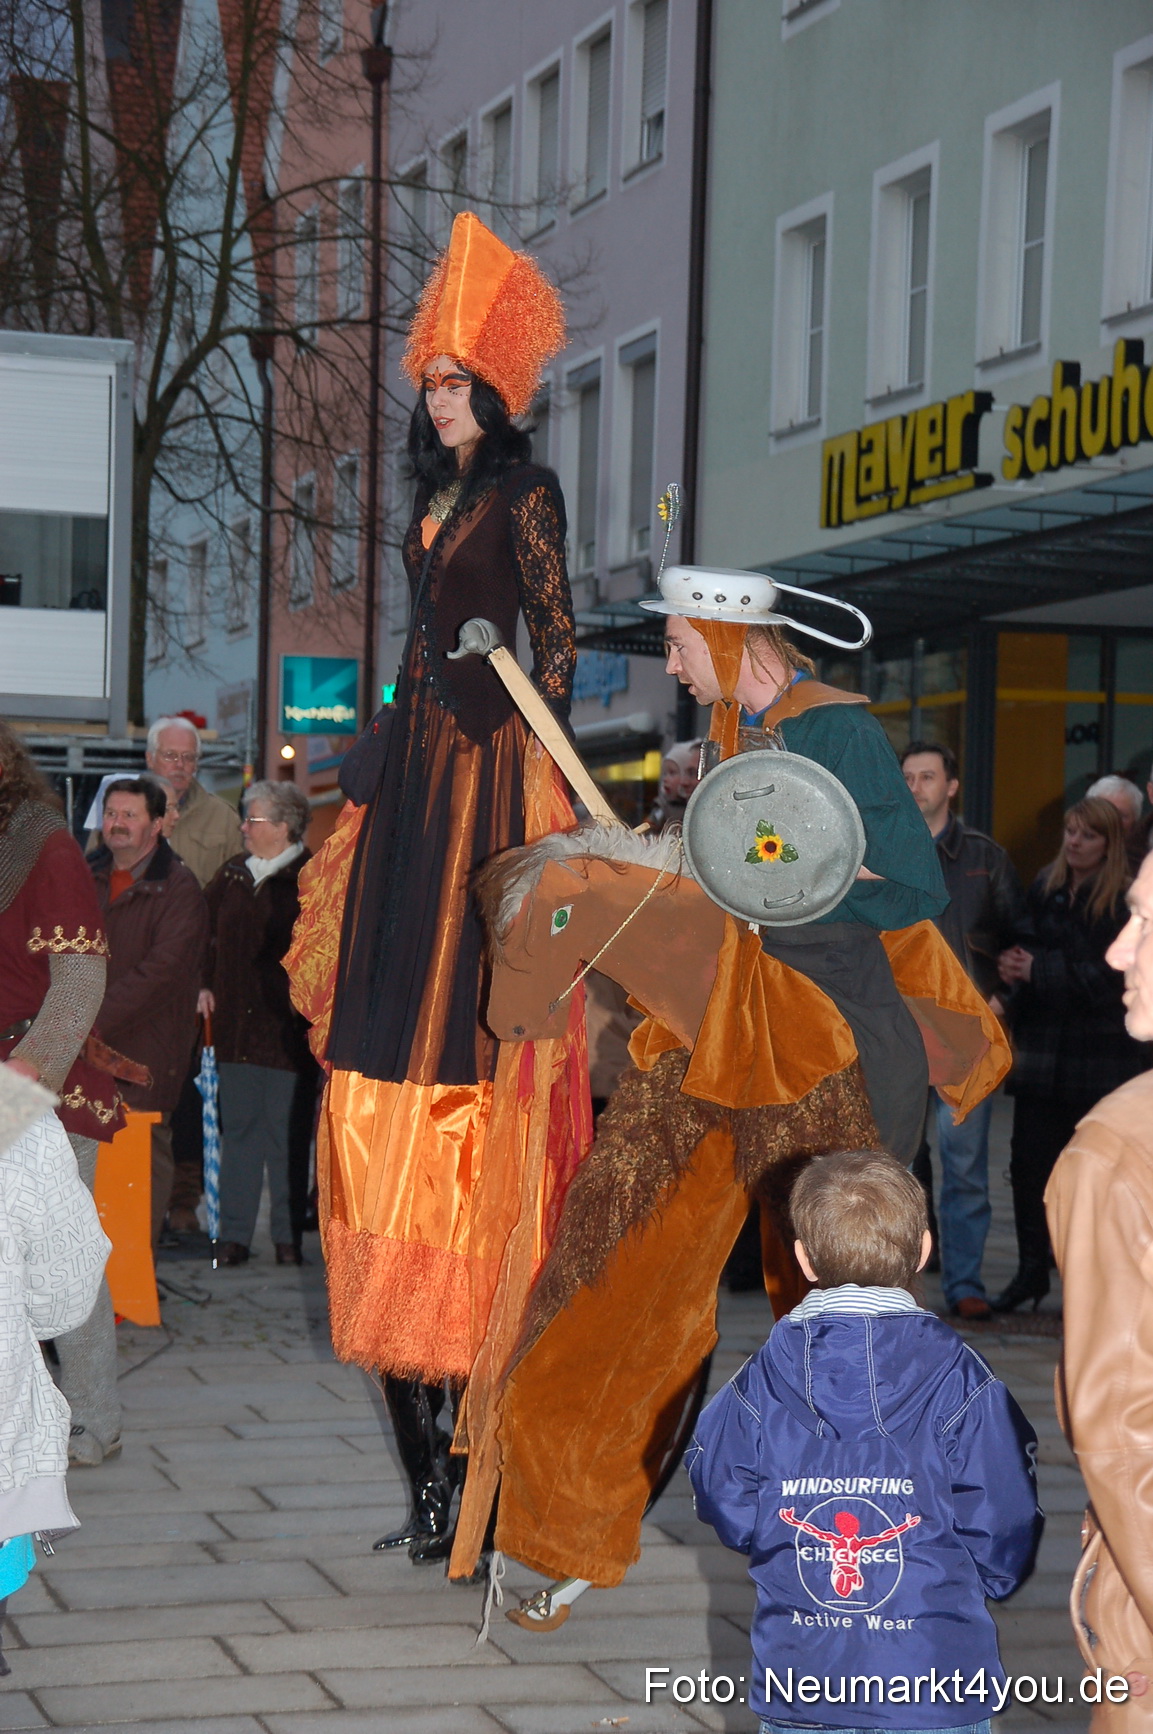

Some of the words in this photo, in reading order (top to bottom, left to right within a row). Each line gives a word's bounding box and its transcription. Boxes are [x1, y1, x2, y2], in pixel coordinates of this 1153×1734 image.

[820, 390, 977, 528] mayer
[781, 1477, 914, 1497] WINDSURFING
[791, 1611, 853, 1628] Active
[864, 1614, 915, 1631] Wear
